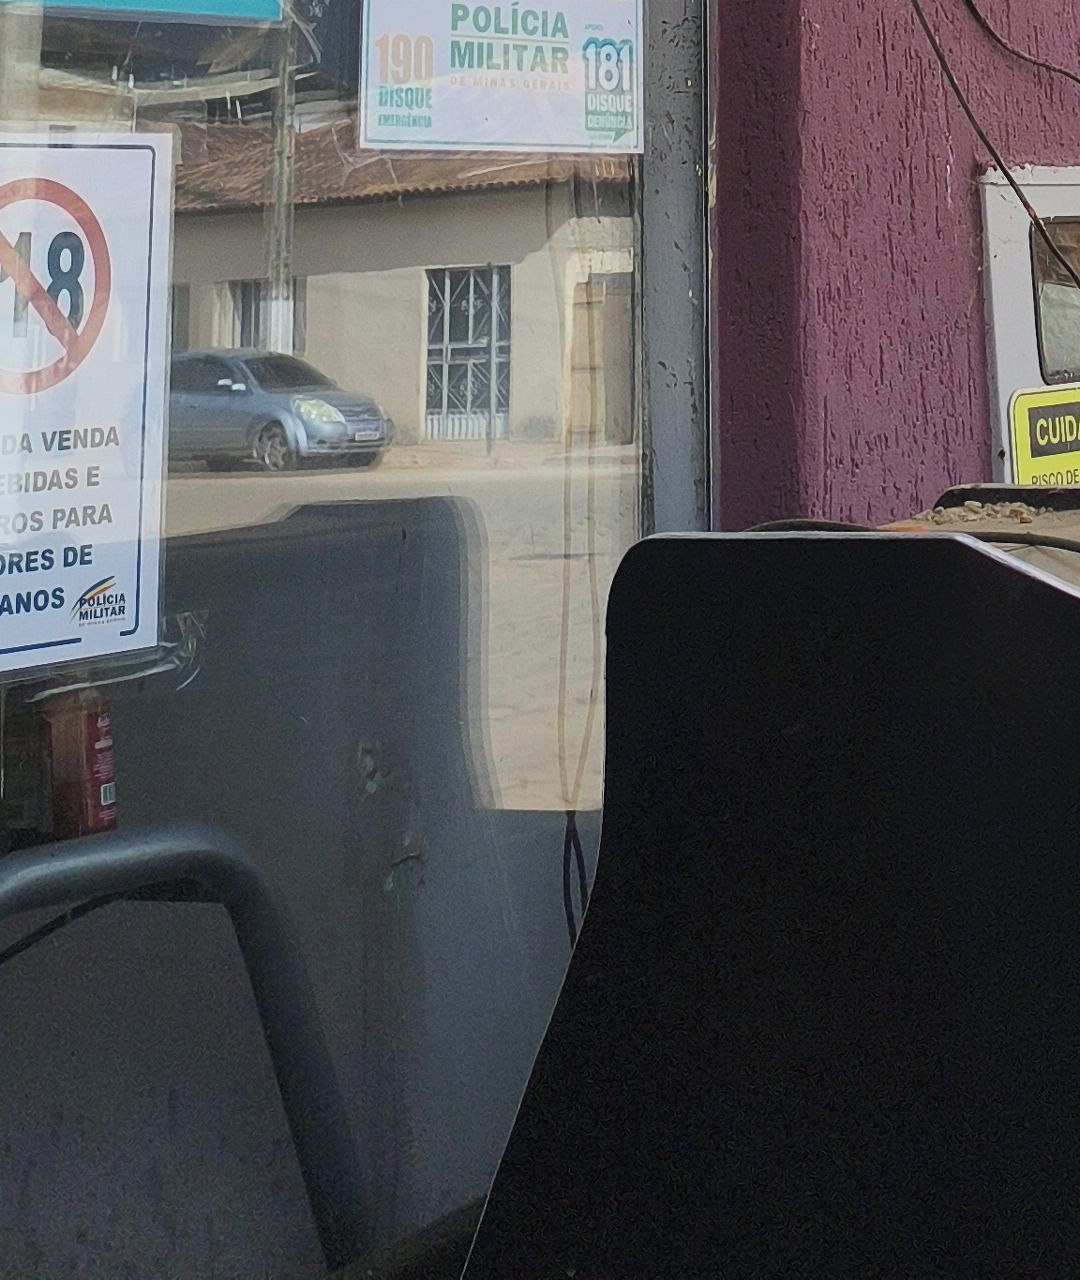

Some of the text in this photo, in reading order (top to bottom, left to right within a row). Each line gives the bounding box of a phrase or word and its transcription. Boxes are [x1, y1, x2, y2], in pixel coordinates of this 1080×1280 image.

[451, 1, 569, 39] POLÍCIA
[375, 33, 434, 85] 190
[451, 40, 569, 74] MILITAR
[583, 39, 632, 92] 181
[450, 76, 570, 90] DE MINAS GERAIS
[378, 86, 432, 110] DISQUE
[587, 94, 632, 113] DISQUE
[41, 426, 120, 452] VENDA
[87, 466, 100, 487] E
[1066, 469, 1079, 485] DE
[52, 503, 113, 530] PARA
[63, 544, 93, 568] DE
[0, 587, 65, 617] ANOS
[79, 605, 125, 621] MILITAR
